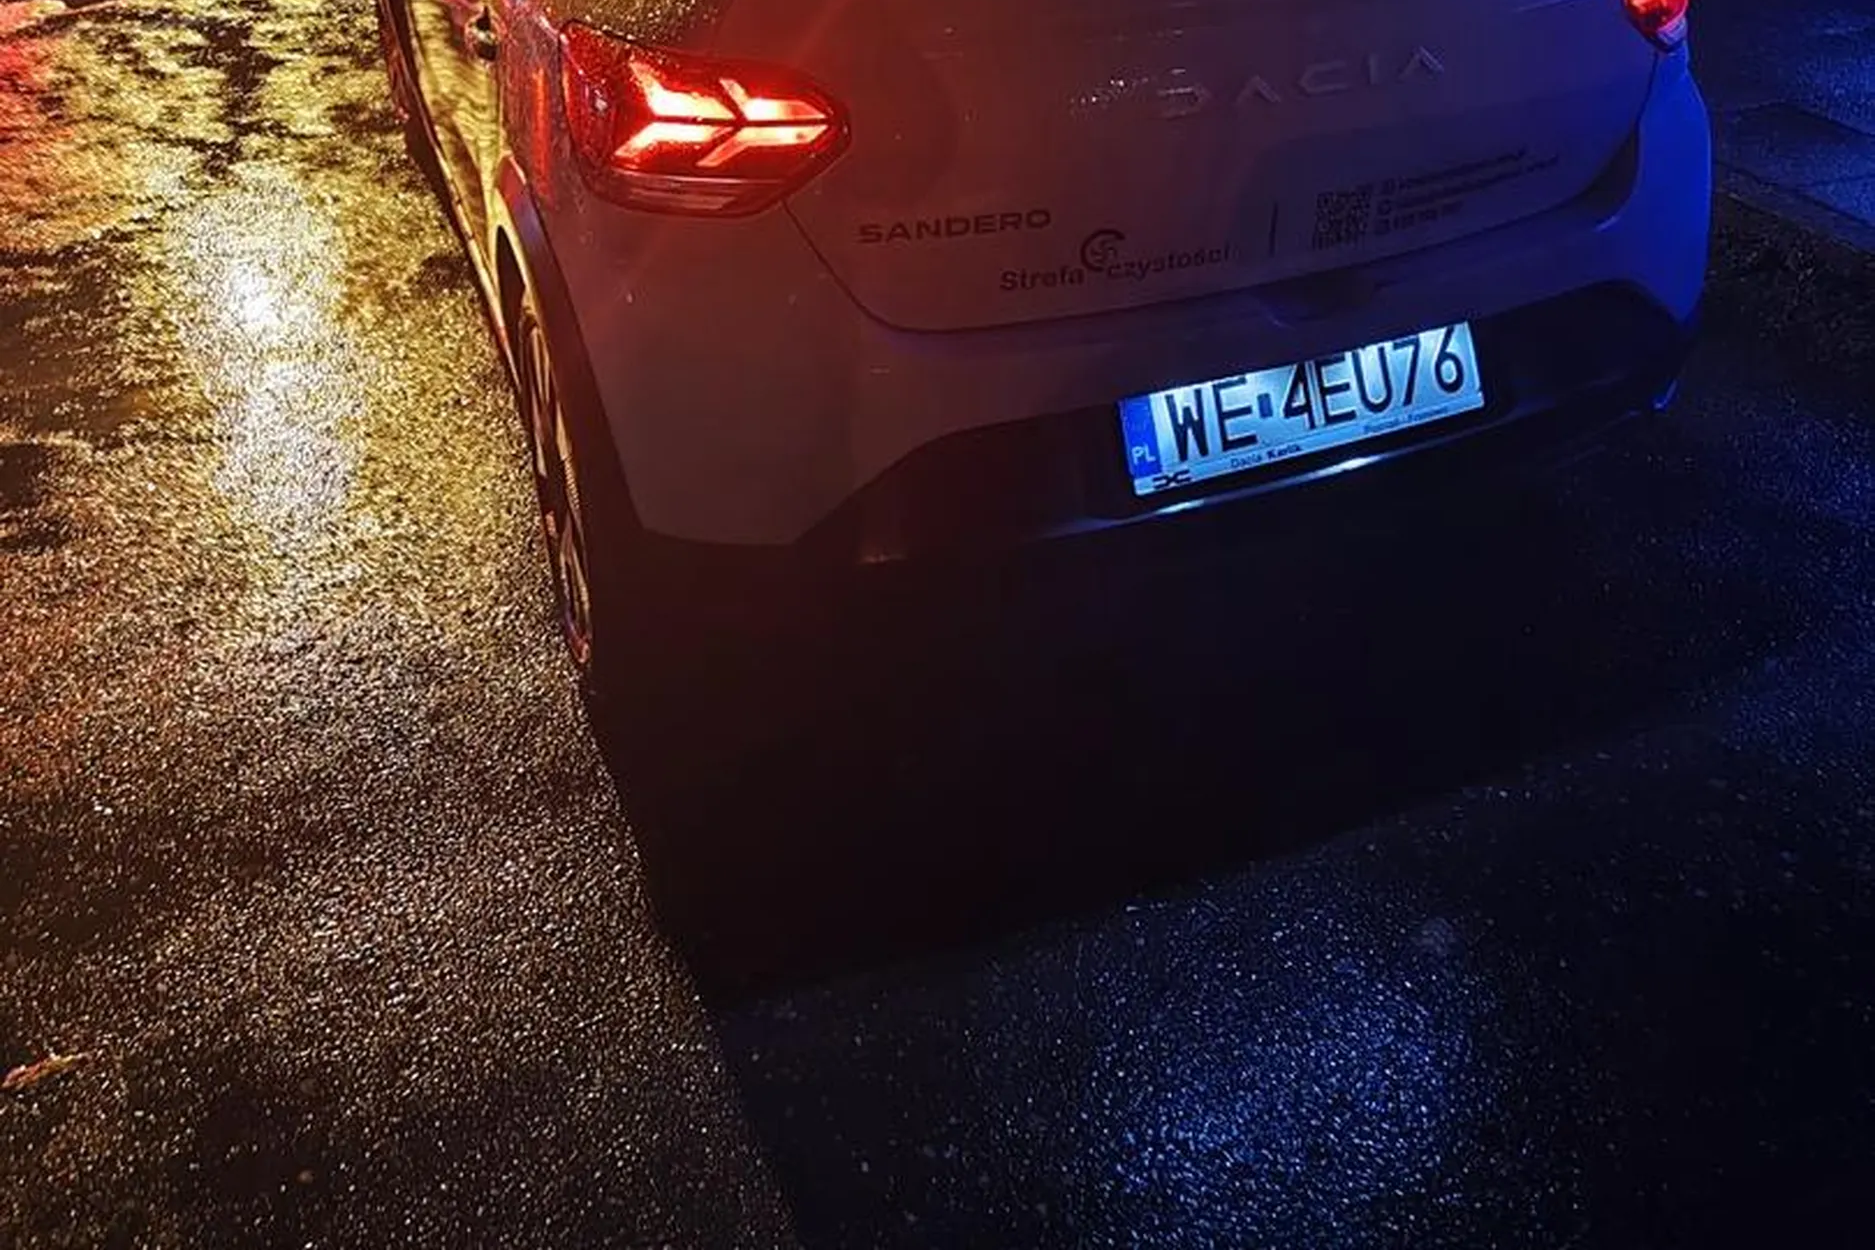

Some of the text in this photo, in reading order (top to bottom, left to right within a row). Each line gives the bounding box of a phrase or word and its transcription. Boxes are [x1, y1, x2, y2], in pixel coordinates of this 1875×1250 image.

[1156, 45, 1446, 119] DACIA
[858, 209, 1052, 244] SANDERO
[999, 265, 1085, 291] Strefa
[1164, 327, 1464, 462] WE 4EU76
[1131, 444, 1157, 465] PL
